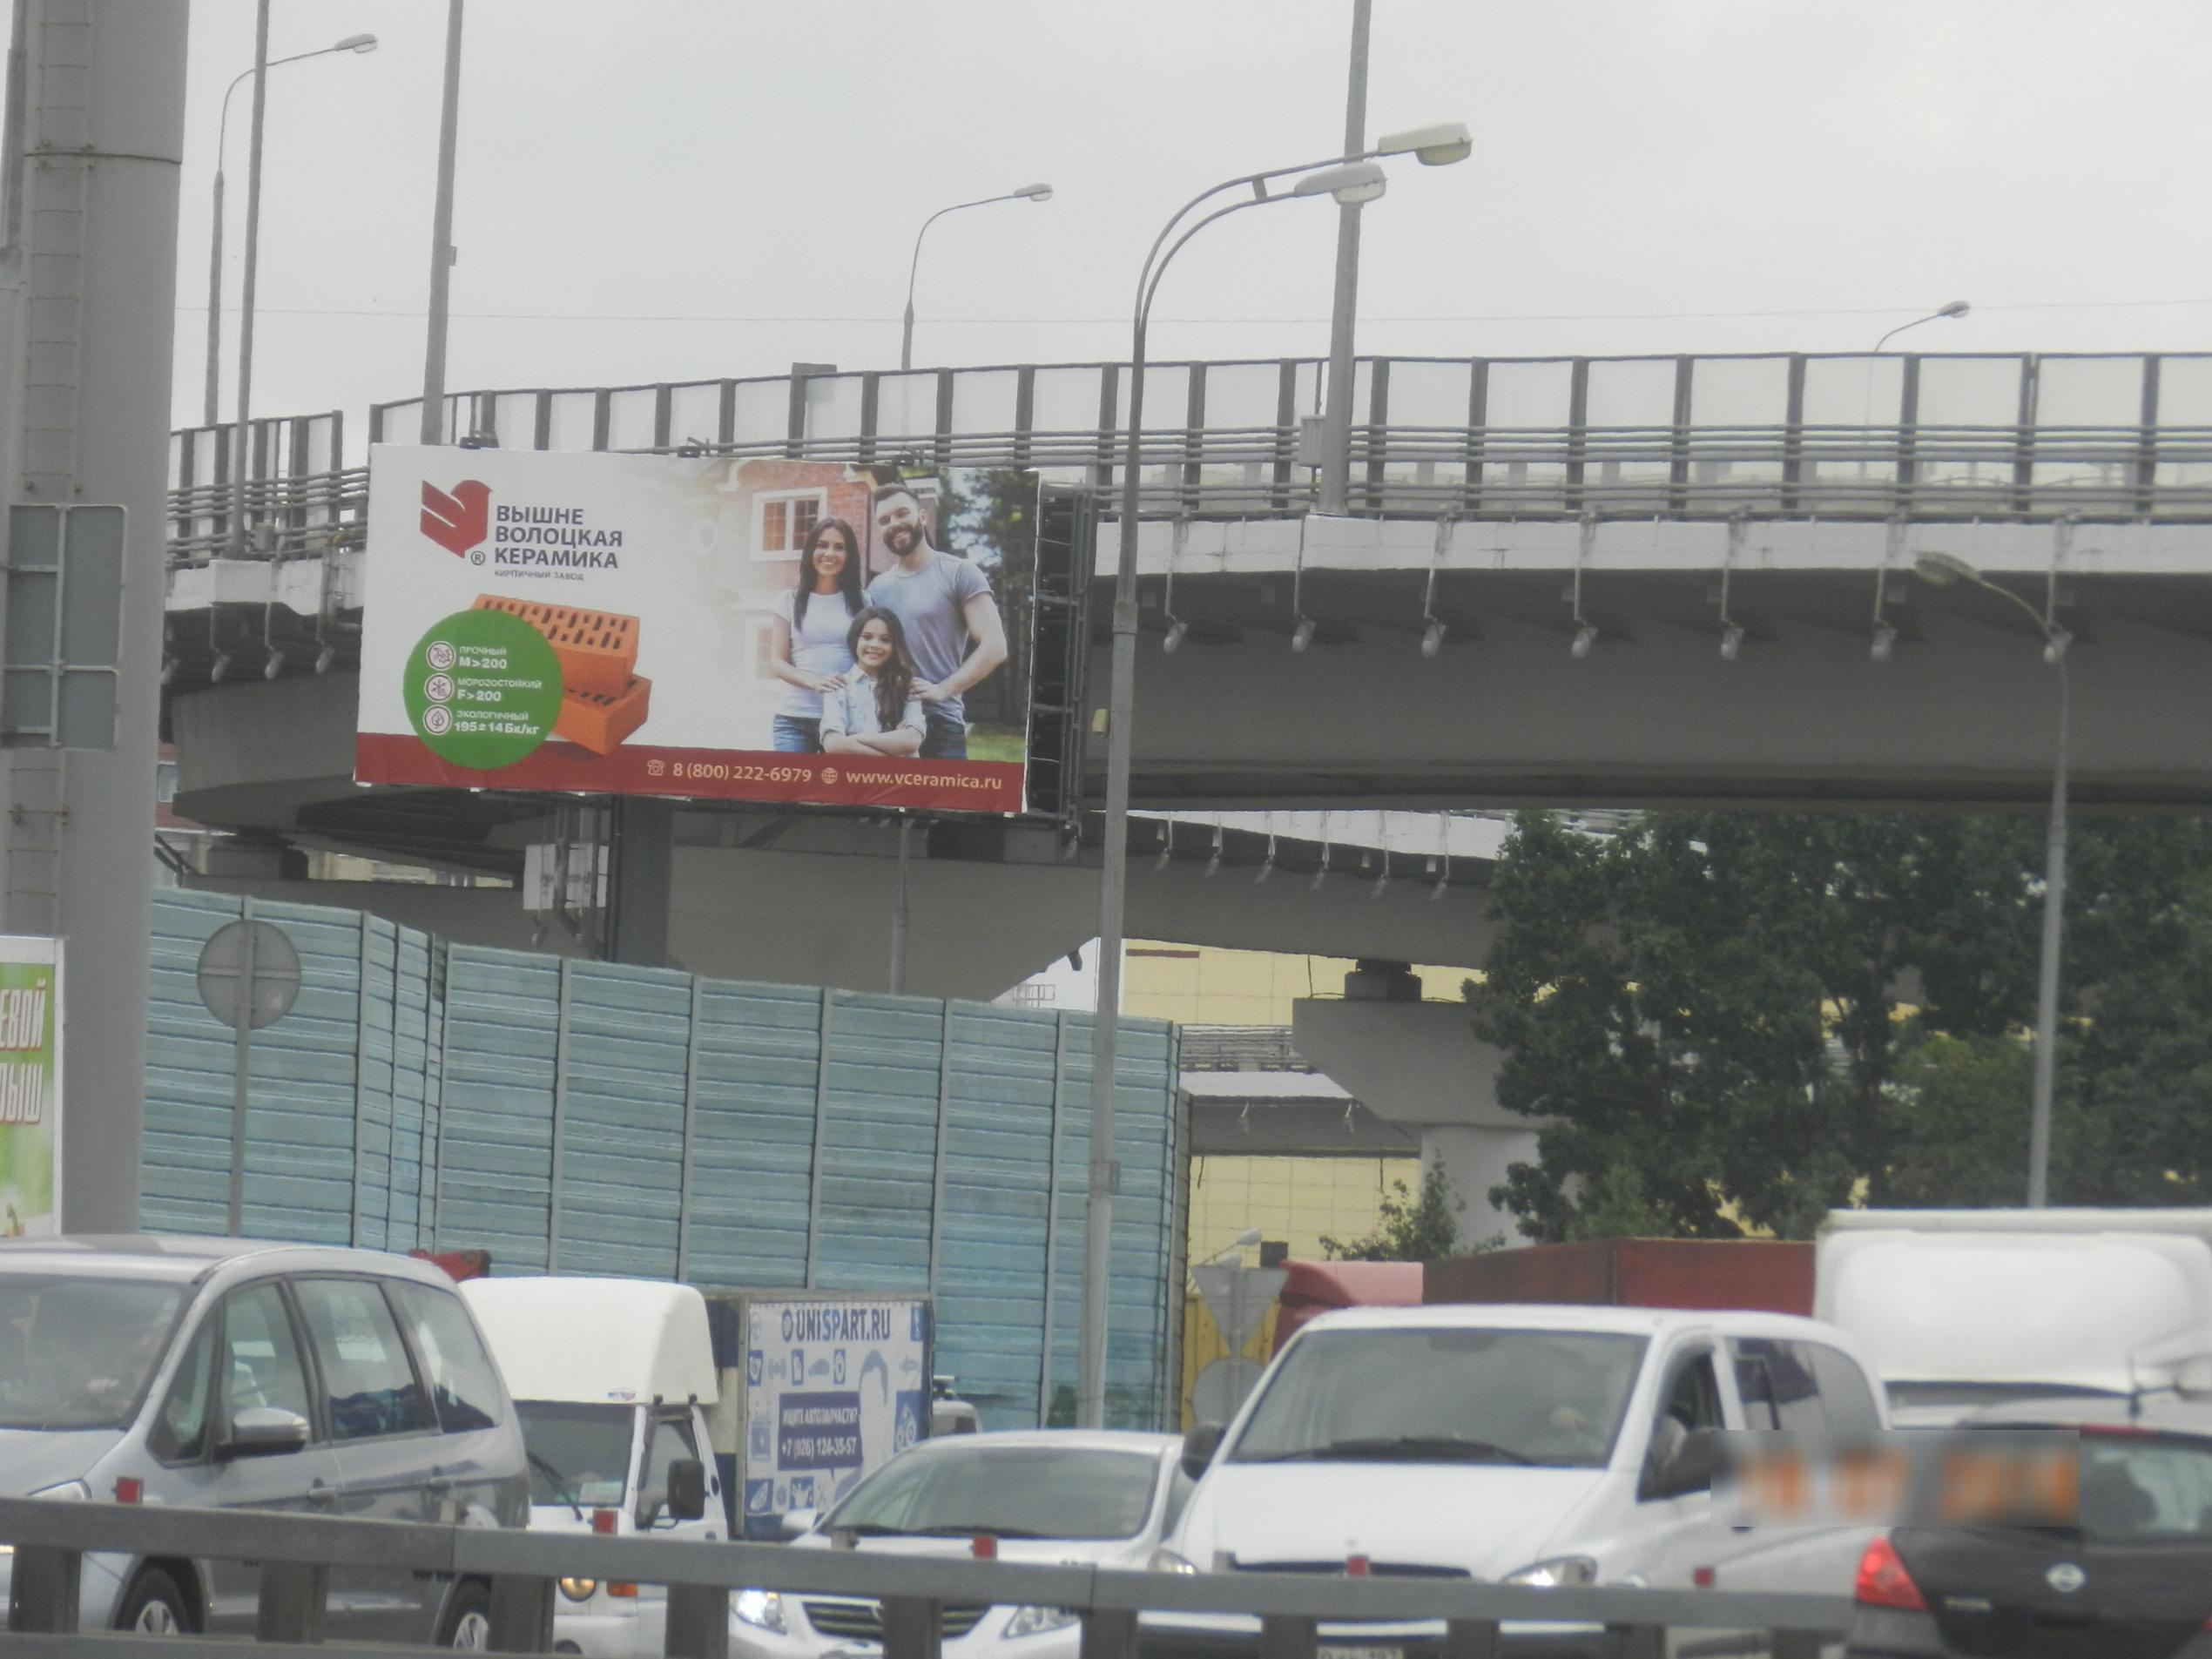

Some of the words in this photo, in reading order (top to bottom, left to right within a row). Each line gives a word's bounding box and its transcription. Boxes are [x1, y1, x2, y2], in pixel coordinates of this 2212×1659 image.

[496, 505, 583, 525] ВЫШНЕ
[495, 525, 624, 548] ВОЛОЦКАЯ
[495, 547, 619, 569] КЕРАМИКА
[495, 569, 550, 579] КИРПИЧНЫЙ
[554, 570, 584, 581] ЗАВОД
[459, 646, 507, 656] ПРОЧНЫЙ
[457, 678, 542, 689] МОРОЗОСТОЙКИЙ
[456, 710, 529, 721] ЭКОЛОГИЧНЫЙ
[673, 762, 684, 777] 8
[686, 762, 730, 780] (800)
[732, 765, 813, 782] 222-6979
[846, 771, 1002, 790] www.vceramica.ru
[796, 1308, 891, 1342] UNISPART.RU
